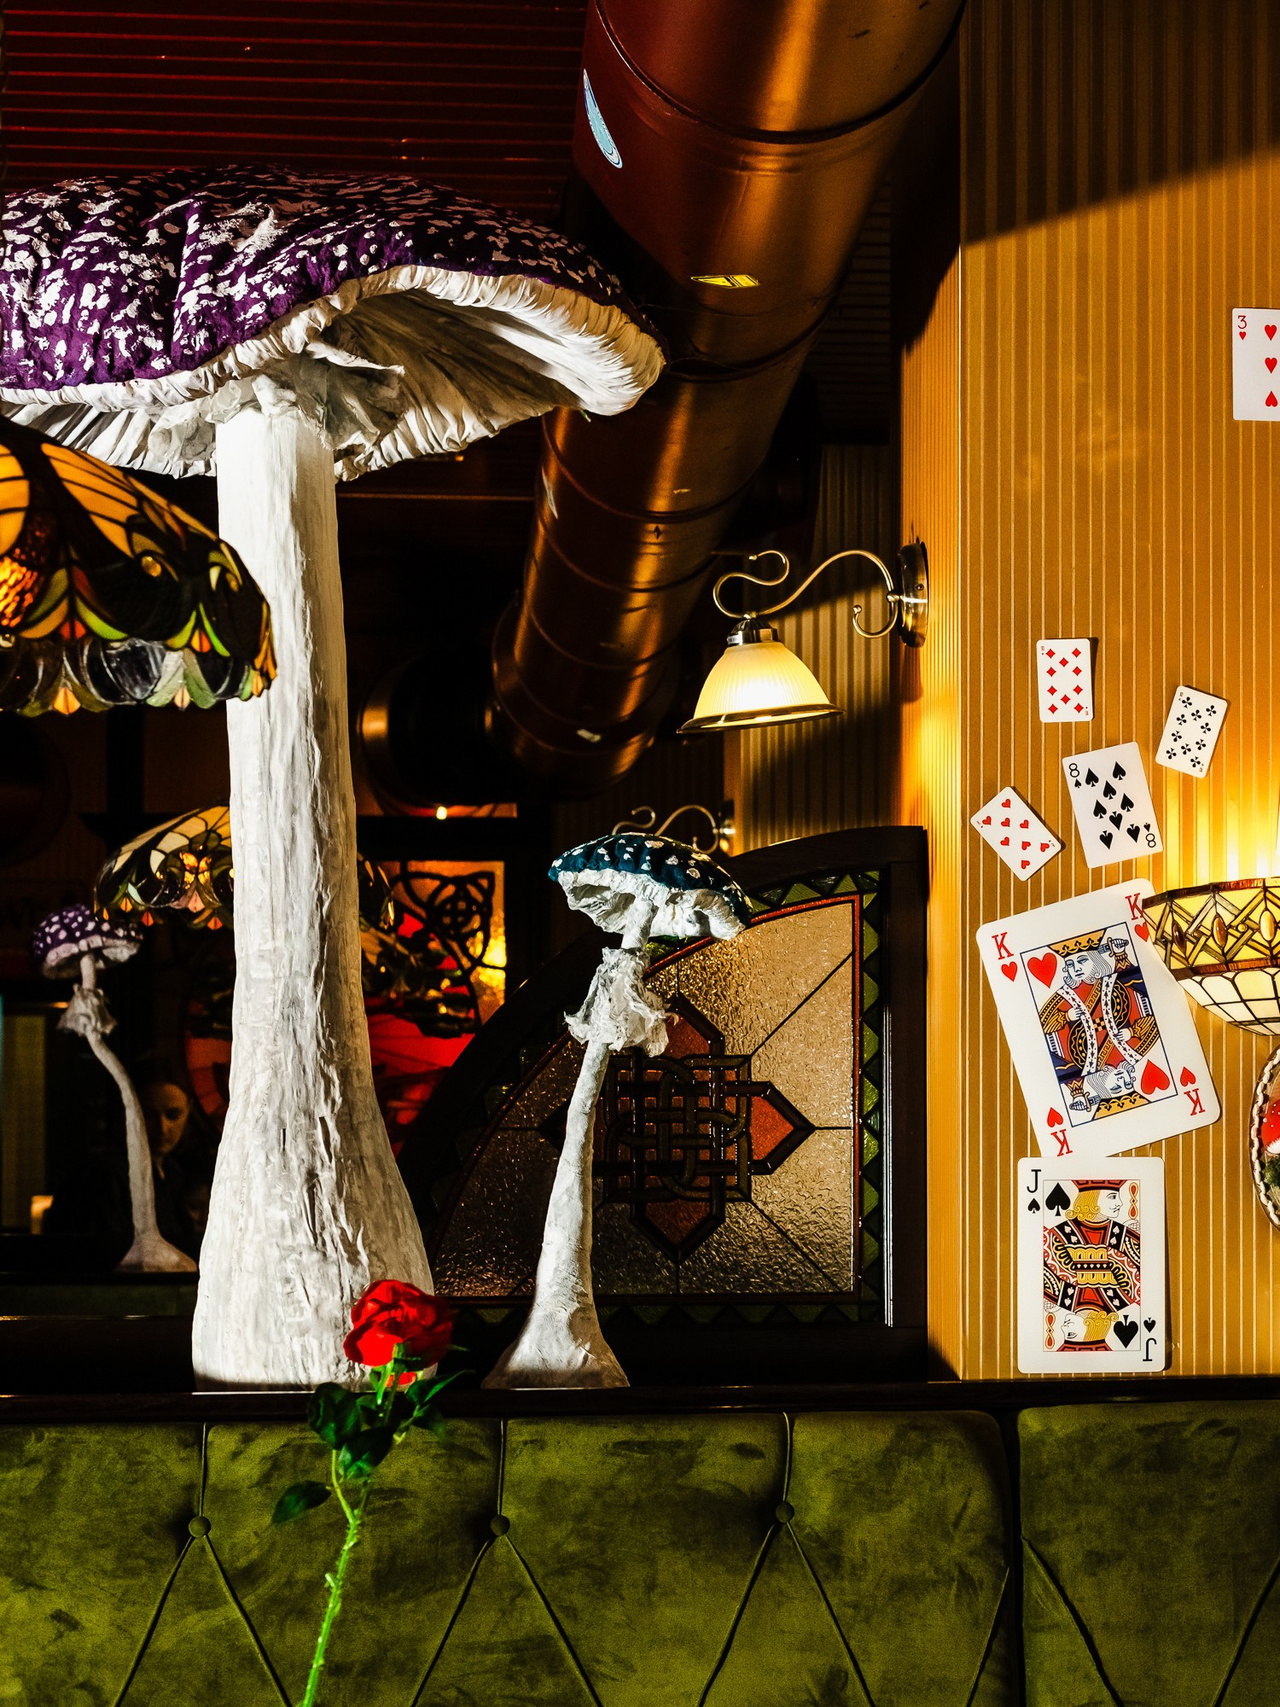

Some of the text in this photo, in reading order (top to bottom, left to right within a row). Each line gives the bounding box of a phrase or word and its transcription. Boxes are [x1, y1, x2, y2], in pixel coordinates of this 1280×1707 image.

[1238, 315, 1247, 329] 3
[1069, 763, 1080, 778] 8
[1145, 833, 1156, 848] 8
[1125, 892, 1144, 920] K
[991, 931, 1014, 960] K
[1184, 1088, 1206, 1116] K
[1050, 1129, 1073, 1157] K
[1026, 1169, 1042, 1193] J
[1142, 1337, 1157, 1362] J
